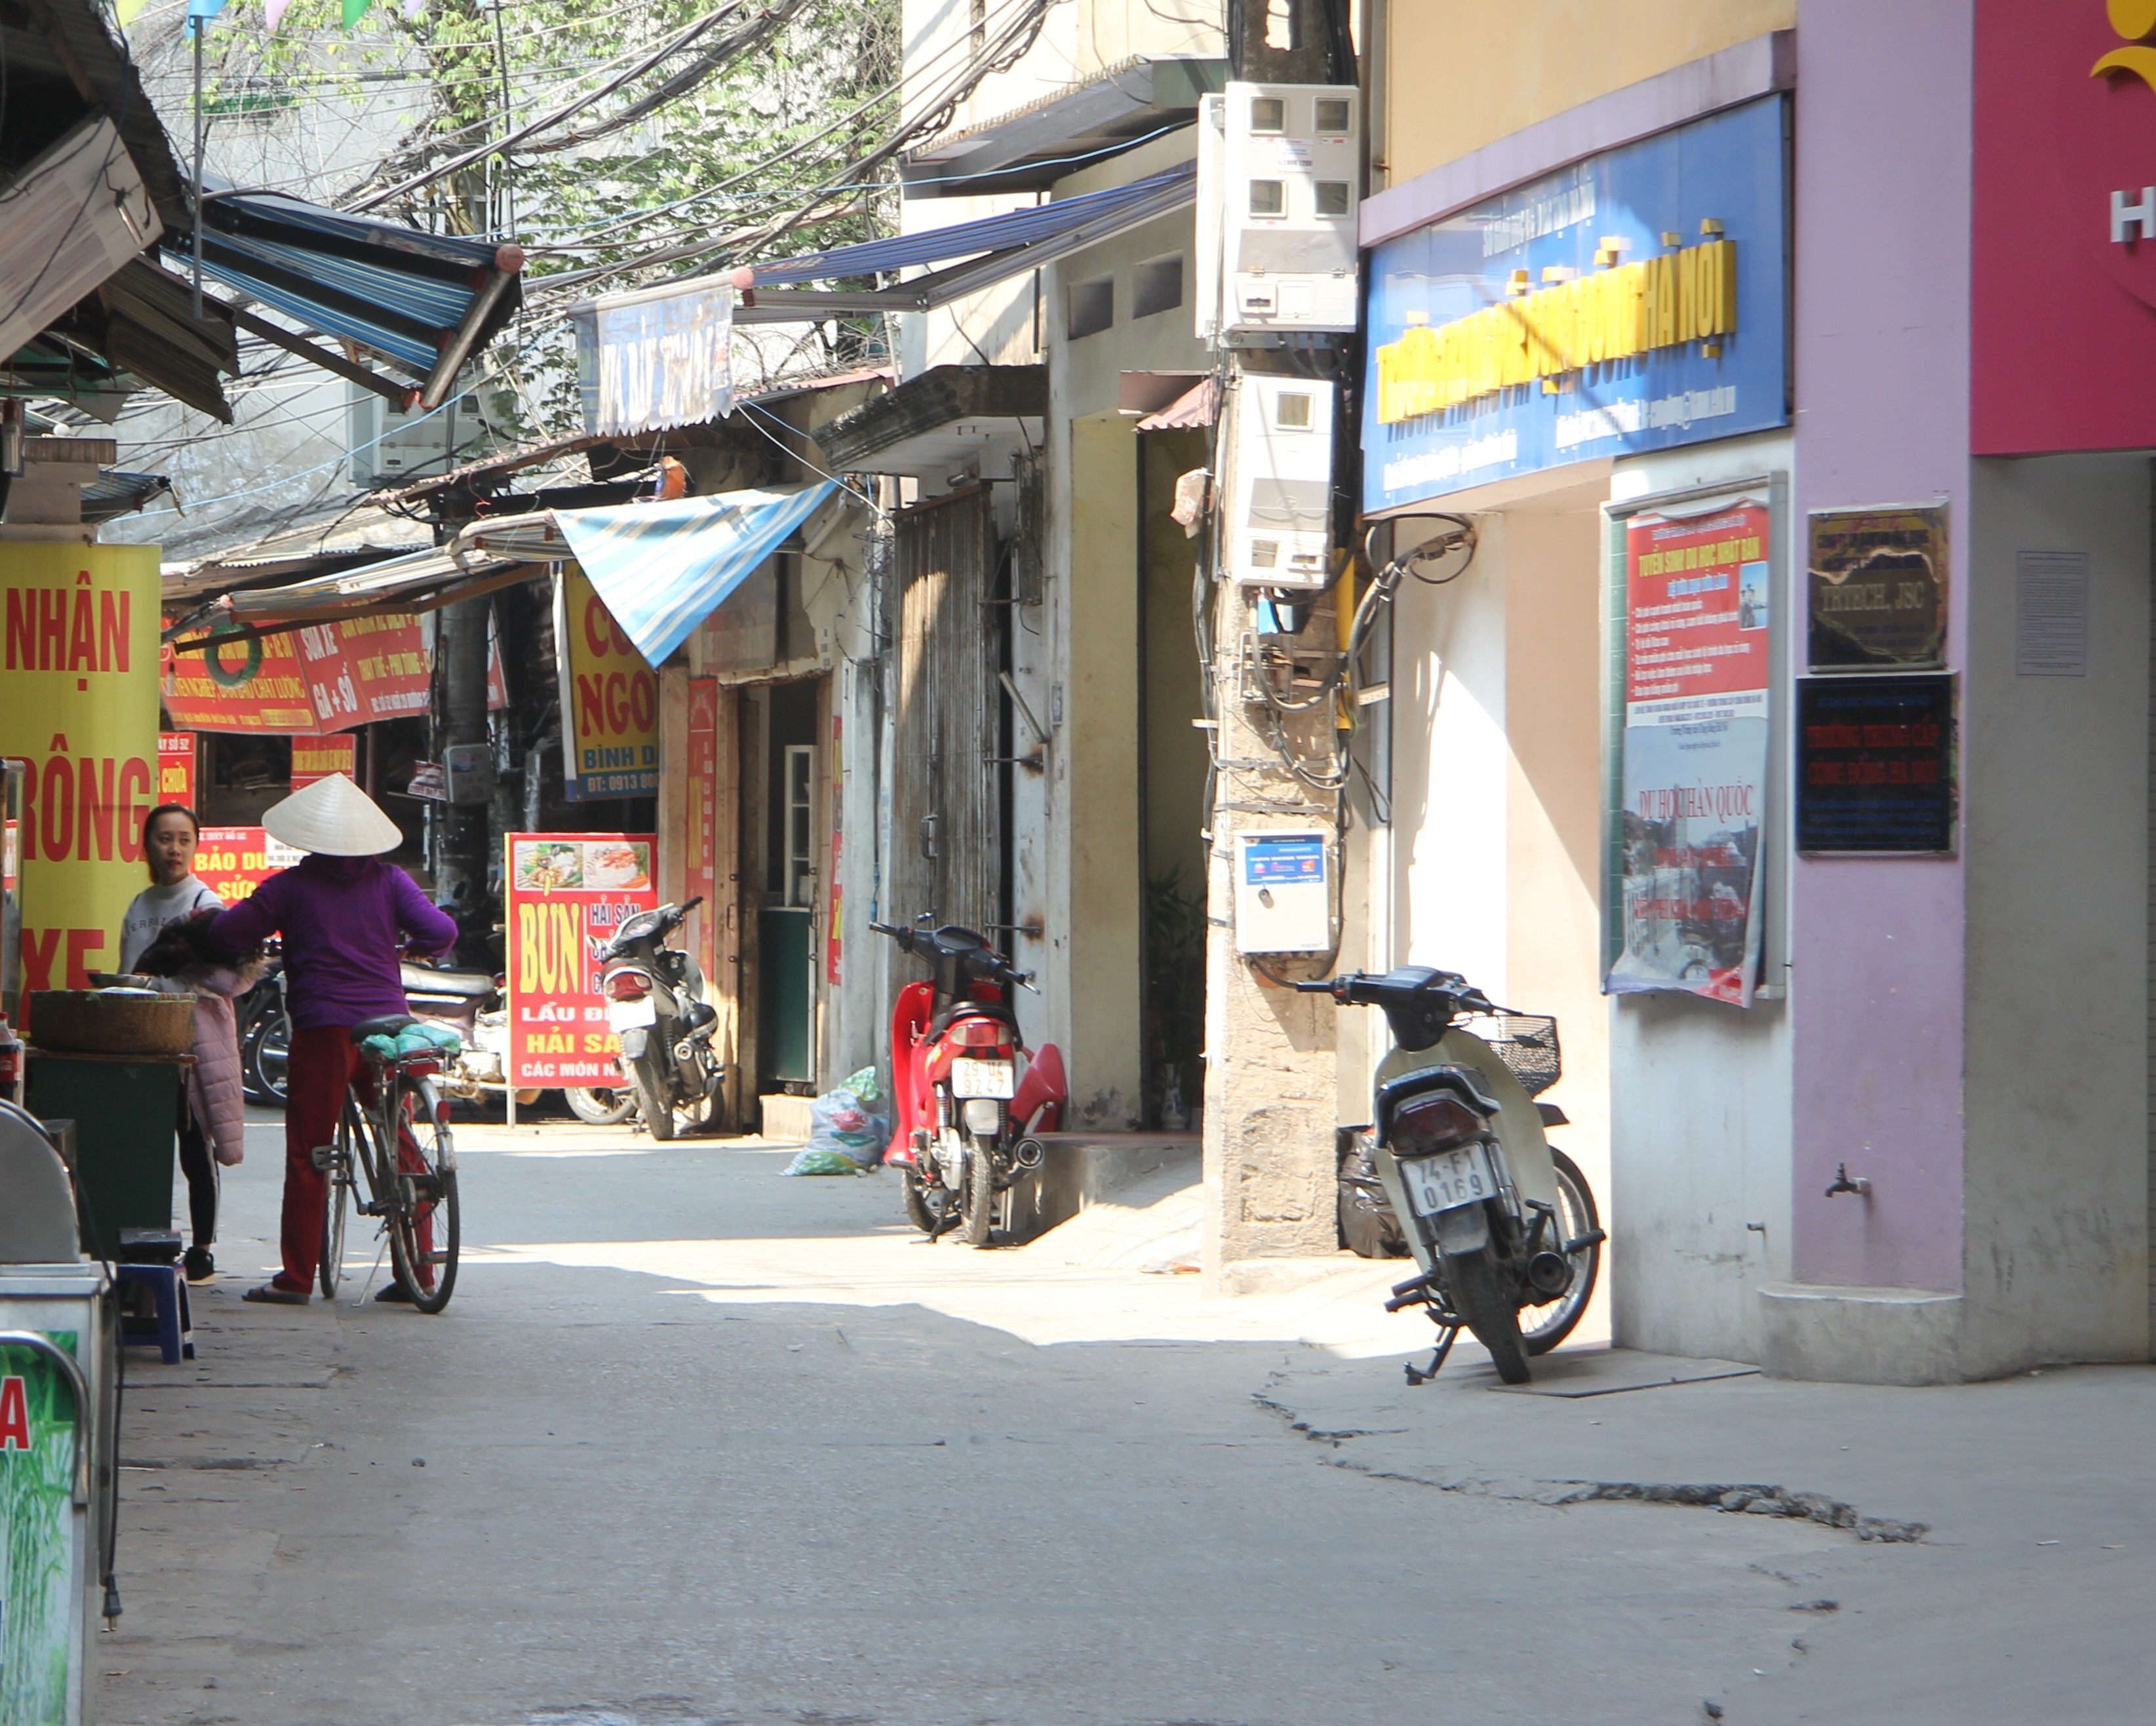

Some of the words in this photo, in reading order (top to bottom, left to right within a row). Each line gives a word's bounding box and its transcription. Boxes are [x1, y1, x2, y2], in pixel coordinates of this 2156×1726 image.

[1643, 232, 1679, 350] HÀ
[1679, 218, 1736, 358] NỘI
[6, 570, 129, 692] NHẬN
[337, 661, 359, 713] SỐ
[578, 669, 658, 737] NGO
[583, 745, 634, 769] BÌNH
[642, 745, 658, 765] D
[3, 733, 150, 863] RÔNG
[194, 845, 237, 871] BẢO
[591, 895, 611, 926] HẢI
[519, 874, 580, 995] BÚN
[522, 1001, 574, 1022] LẨU
[527, 1026, 574, 1054] HẢI
[521, 1061, 555, 1078] CÁC
[560, 1060, 601, 1077] MÓN
[964, 1079, 1006, 1095] 8247
[1424, 1173, 1483, 1208] 0169
